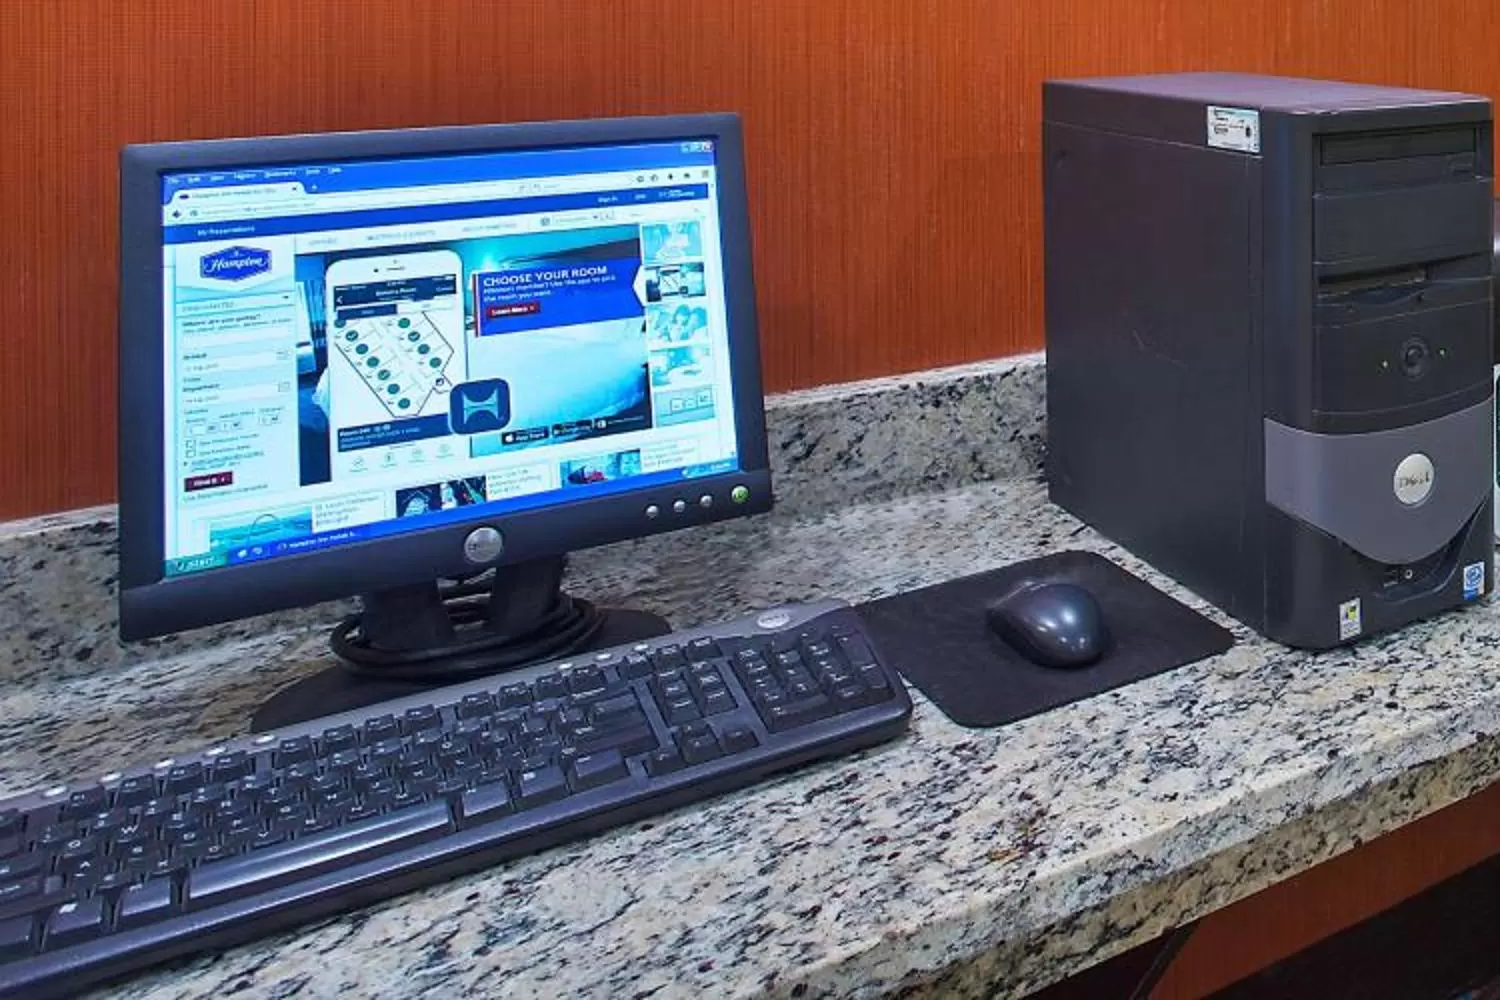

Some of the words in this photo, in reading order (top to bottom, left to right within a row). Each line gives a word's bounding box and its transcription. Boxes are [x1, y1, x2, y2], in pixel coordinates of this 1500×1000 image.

[204, 255, 267, 273] Hampton
[484, 274, 532, 286] CHOOSE
[535, 270, 569, 281] YOUR
[571, 266, 608, 277] ROOM
